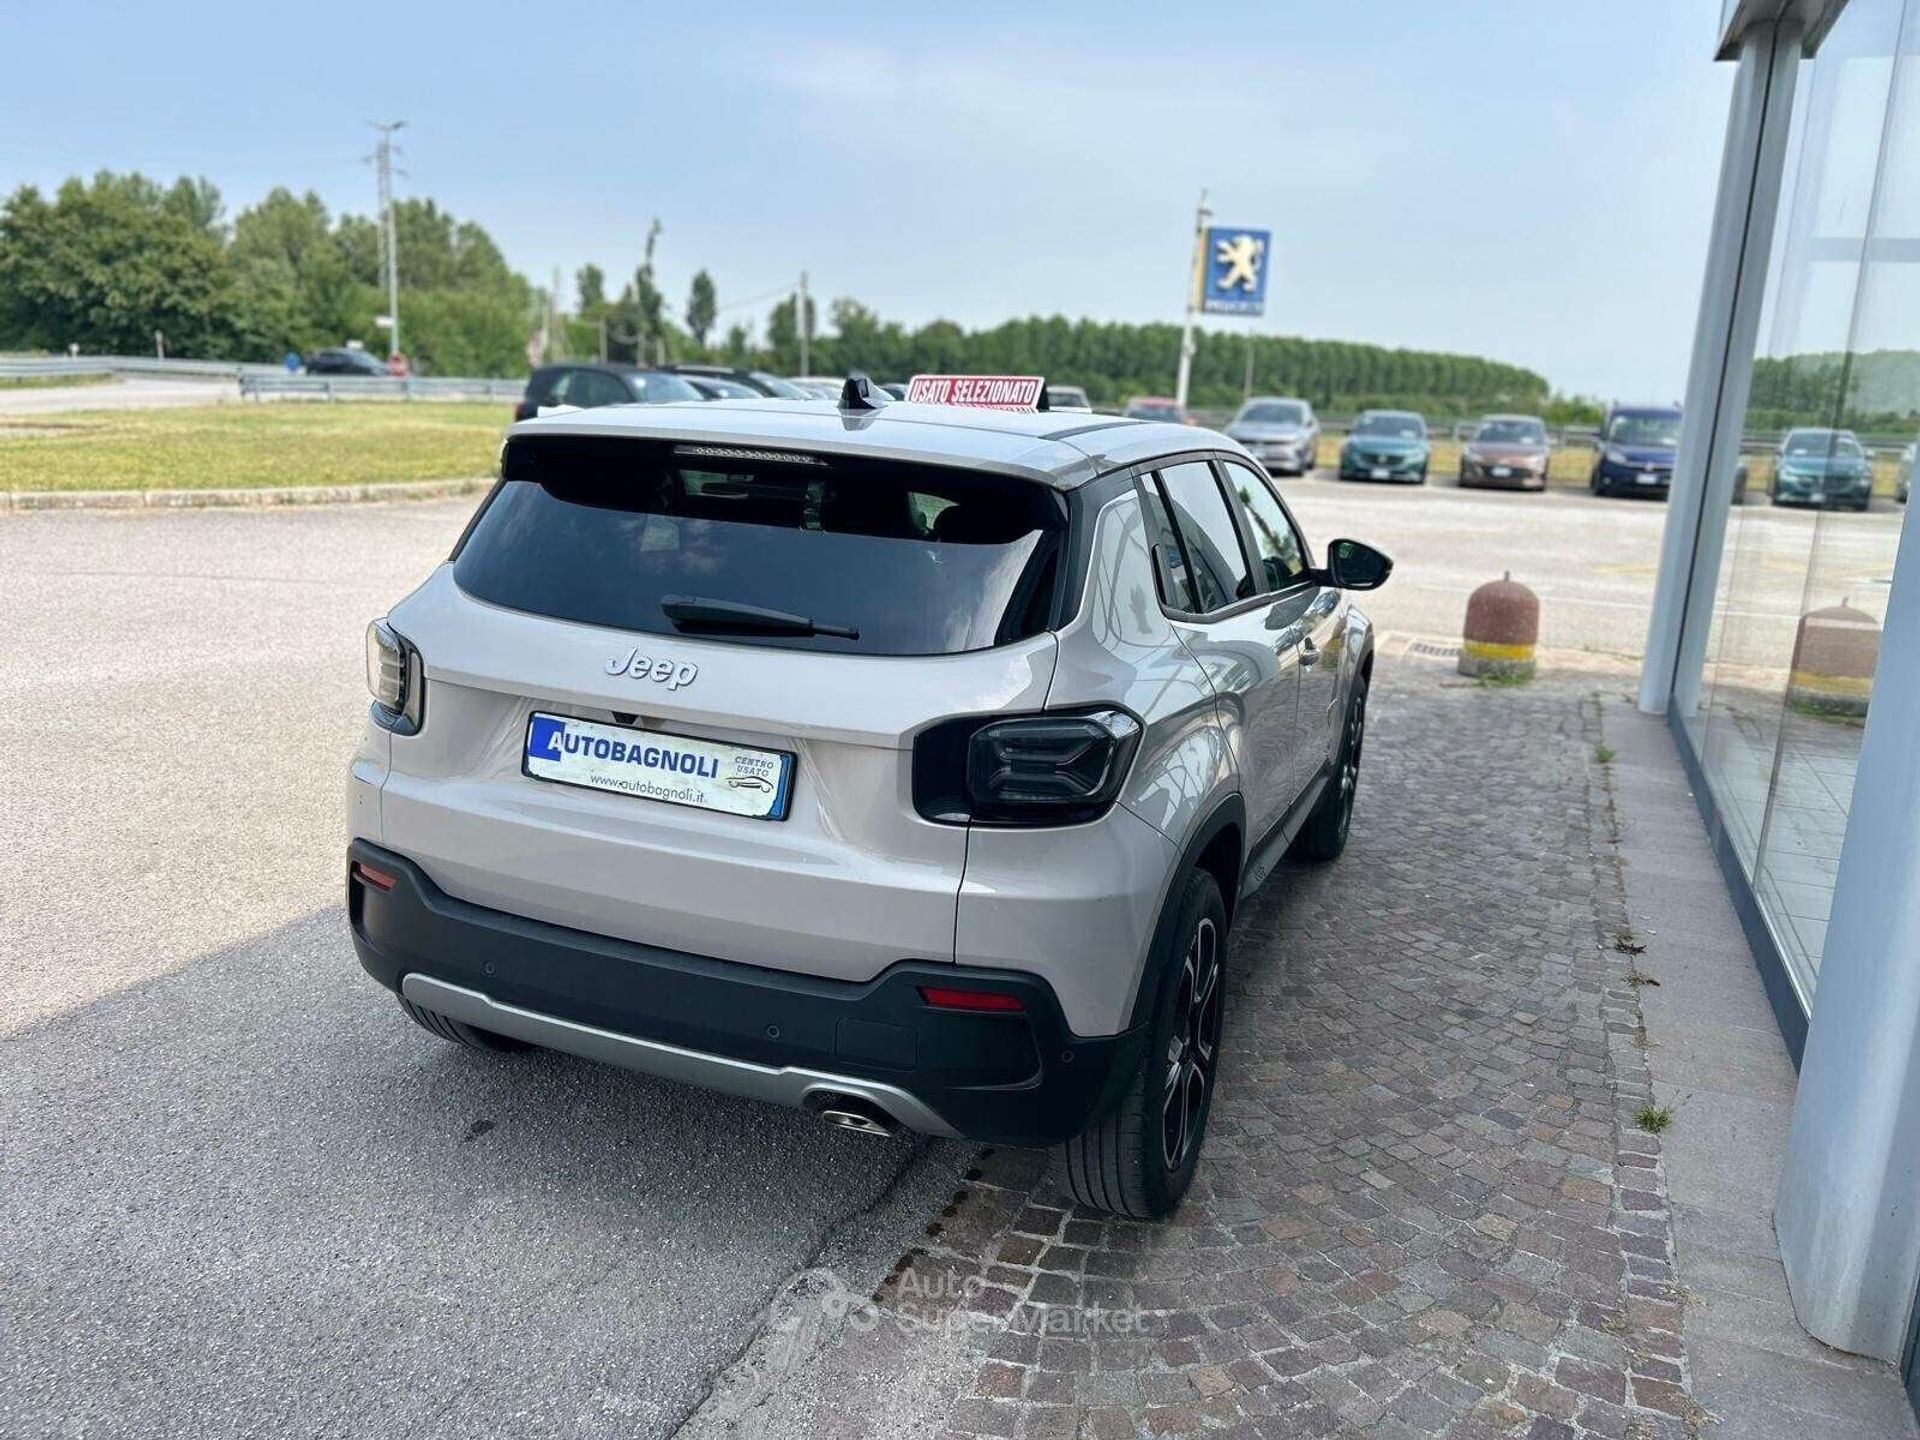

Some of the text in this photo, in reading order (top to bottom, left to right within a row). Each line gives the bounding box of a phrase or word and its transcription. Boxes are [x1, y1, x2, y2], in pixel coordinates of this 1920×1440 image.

[910, 379, 1036, 404] USATO SELEZIONATO
[604, 645, 698, 691] Jeep
[548, 731, 718, 778] AUTOBAGNOLI
[734, 756, 774, 769] CENTRO
[736, 765, 769, 777] USATO
[590, 773, 705, 804] www.autobagnoli.it
